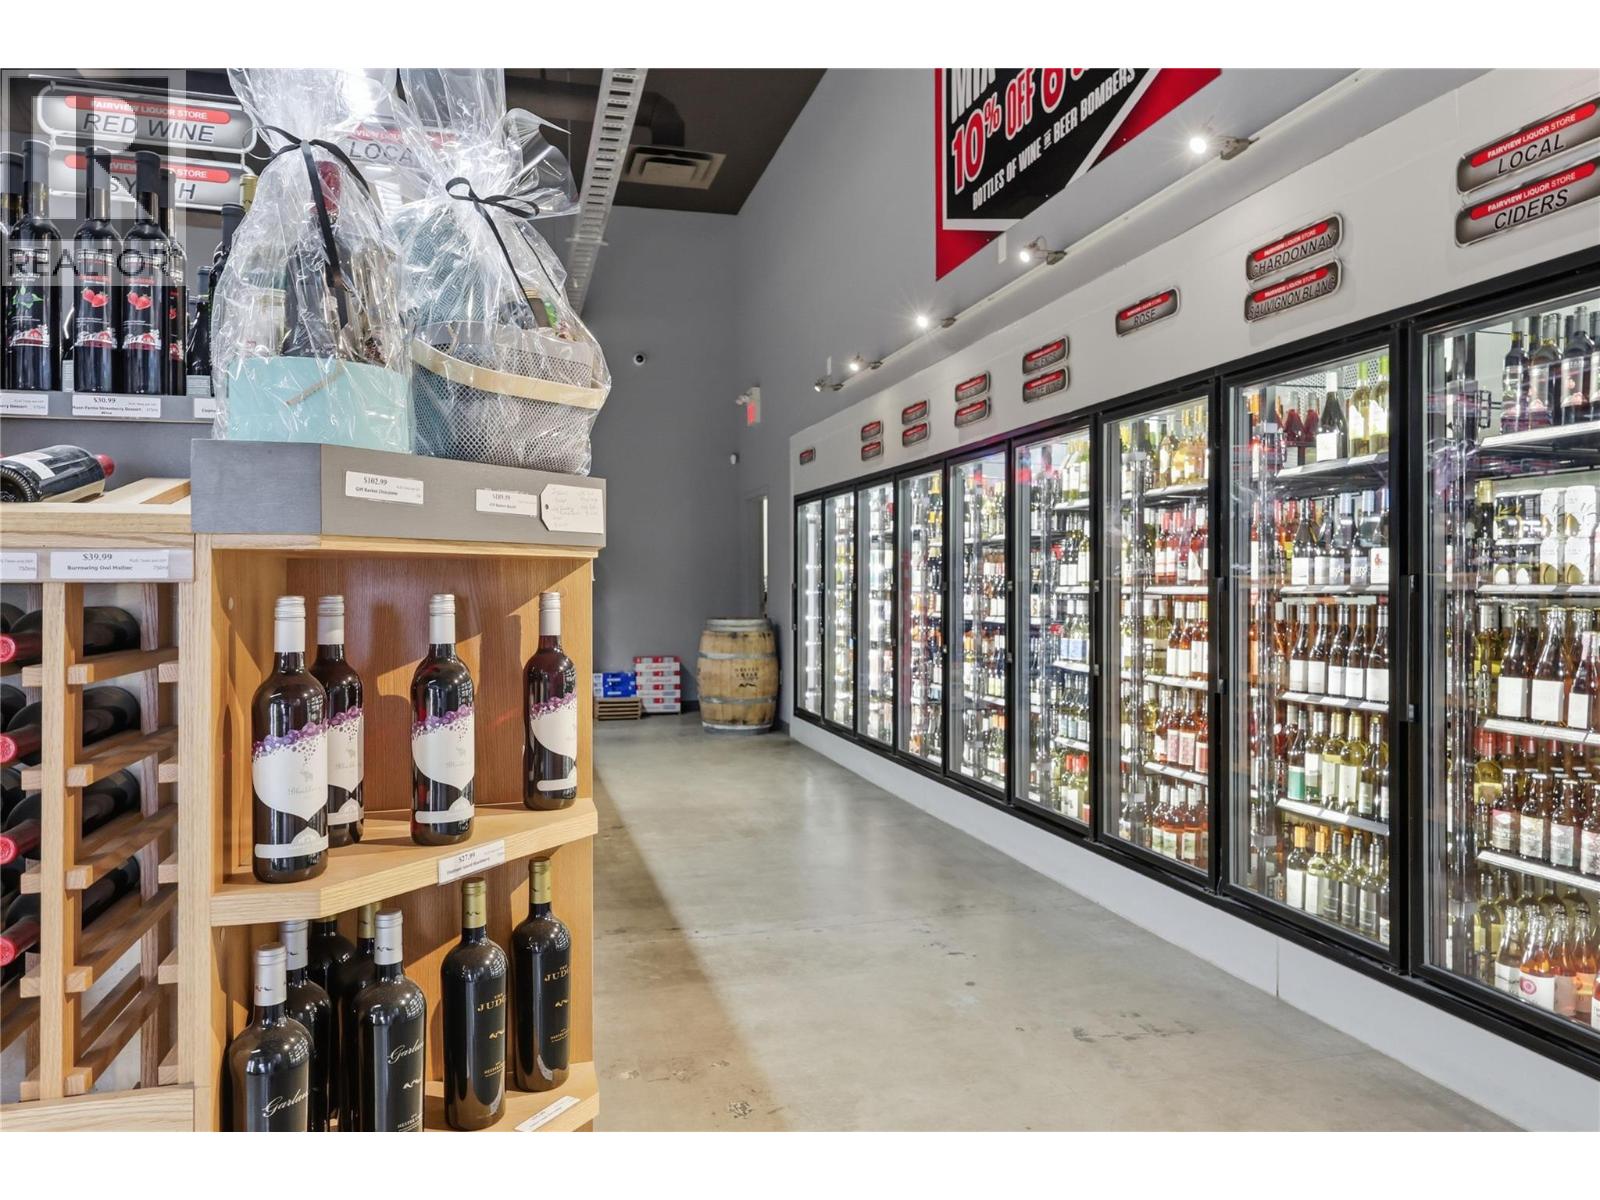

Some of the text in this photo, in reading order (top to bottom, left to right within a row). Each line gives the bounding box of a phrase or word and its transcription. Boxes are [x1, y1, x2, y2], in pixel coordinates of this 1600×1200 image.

[91, 100, 208, 120] FAIRVIEW LIQUOR STORE
[83, 113, 215, 143] RED WINE
[951, 68, 1066, 195] 10% OFF 6
[972, 168, 1005, 211] BOTTLES
[1006, 157, 1017, 183] OF
[1018, 136, 1042, 172] WINE
[1053, 106, 1078, 144] BEER
[1080, 68, 1135, 122] BOMBERS
[1488, 113, 1576, 158] FAIRVIEW LIQUOR STORE
[349, 141, 414, 162] LOCA
[1498, 134, 1565, 175] LOCAL
[110, 176, 196, 200] SYH
[176, 169, 207, 178] STORE
[1488, 171, 1576, 212] FAIRVIEW LIQUOR STORE
[1494, 189, 1569, 230] CIDERS
[1251, 230, 1336, 278] CHARDONNAY
[1247, 291, 1301, 320] SAUVIGNON
[82, 553, 113, 561] $39.99
[544, 968, 569, 982] JUD
[477, 995, 506, 1012] JUD
